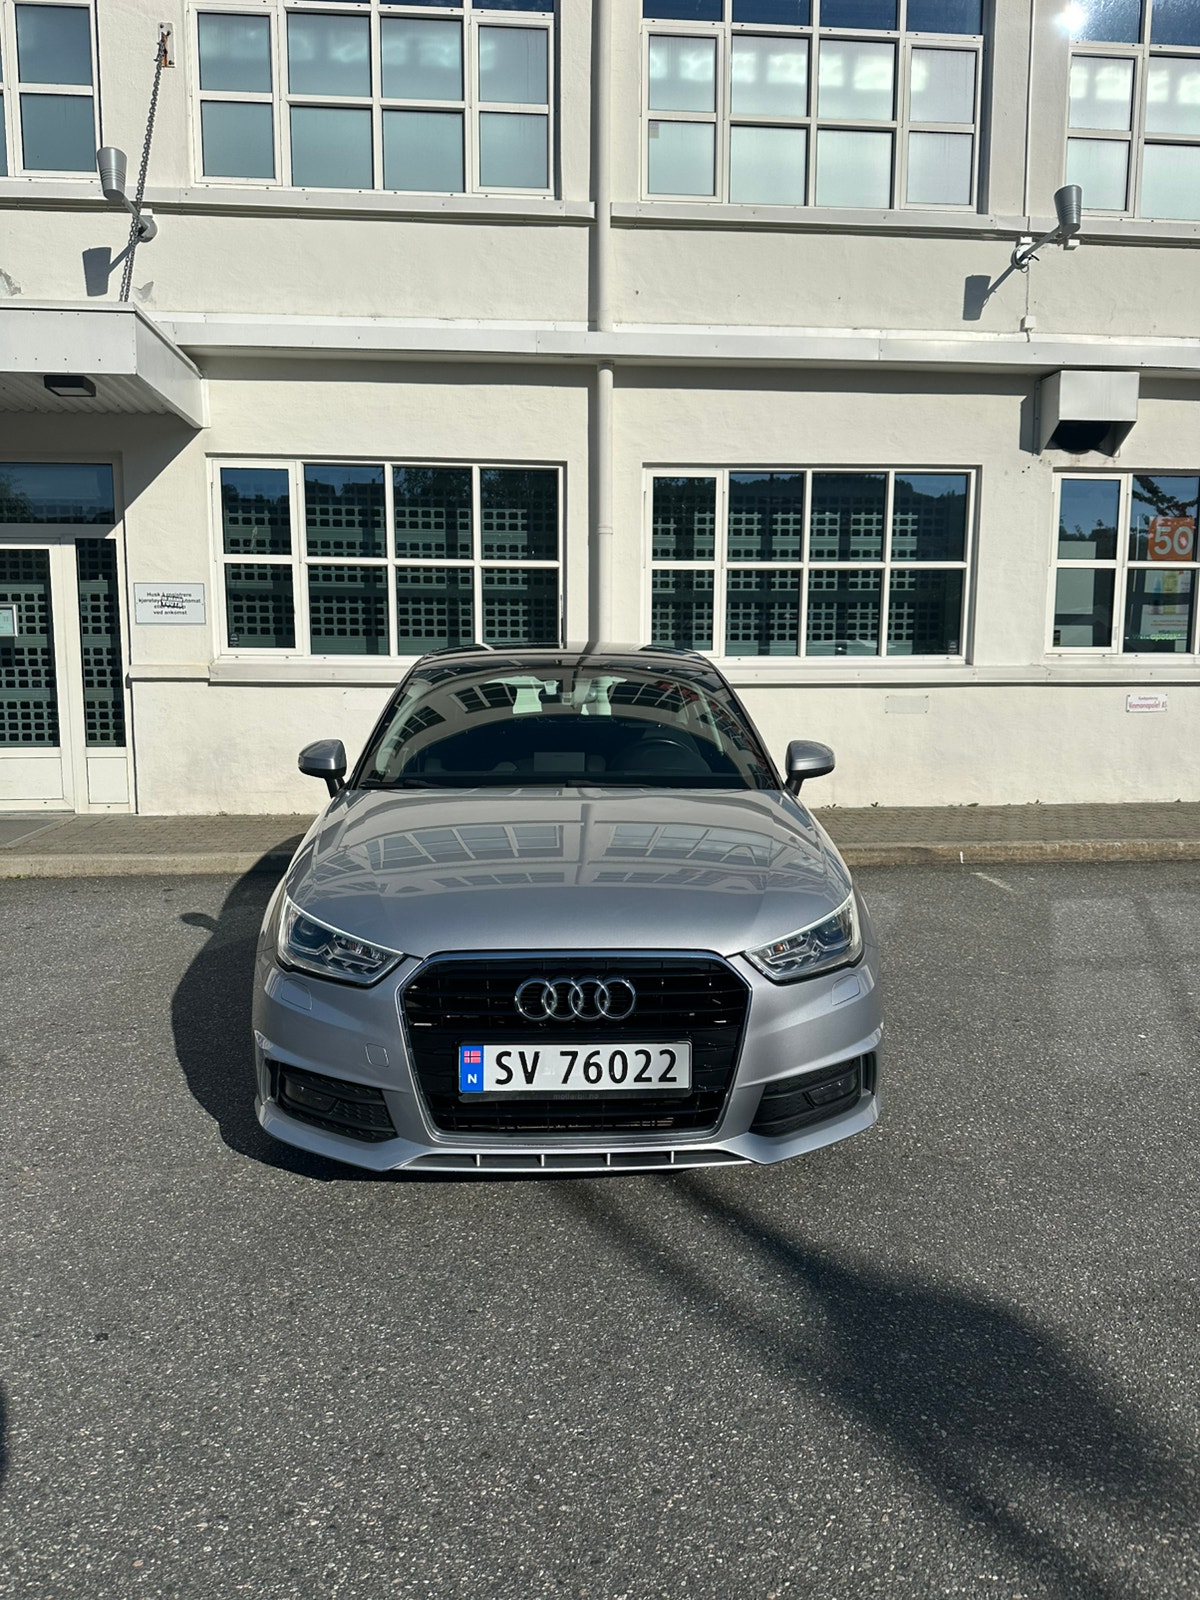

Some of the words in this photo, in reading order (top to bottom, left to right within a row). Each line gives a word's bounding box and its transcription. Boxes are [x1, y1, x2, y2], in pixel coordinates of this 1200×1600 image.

[1154, 526, 1193, 555] 50
[467, 1073, 477, 1084] N
[495, 1050, 540, 1085] SV
[560, 1049, 677, 1085] 76022
